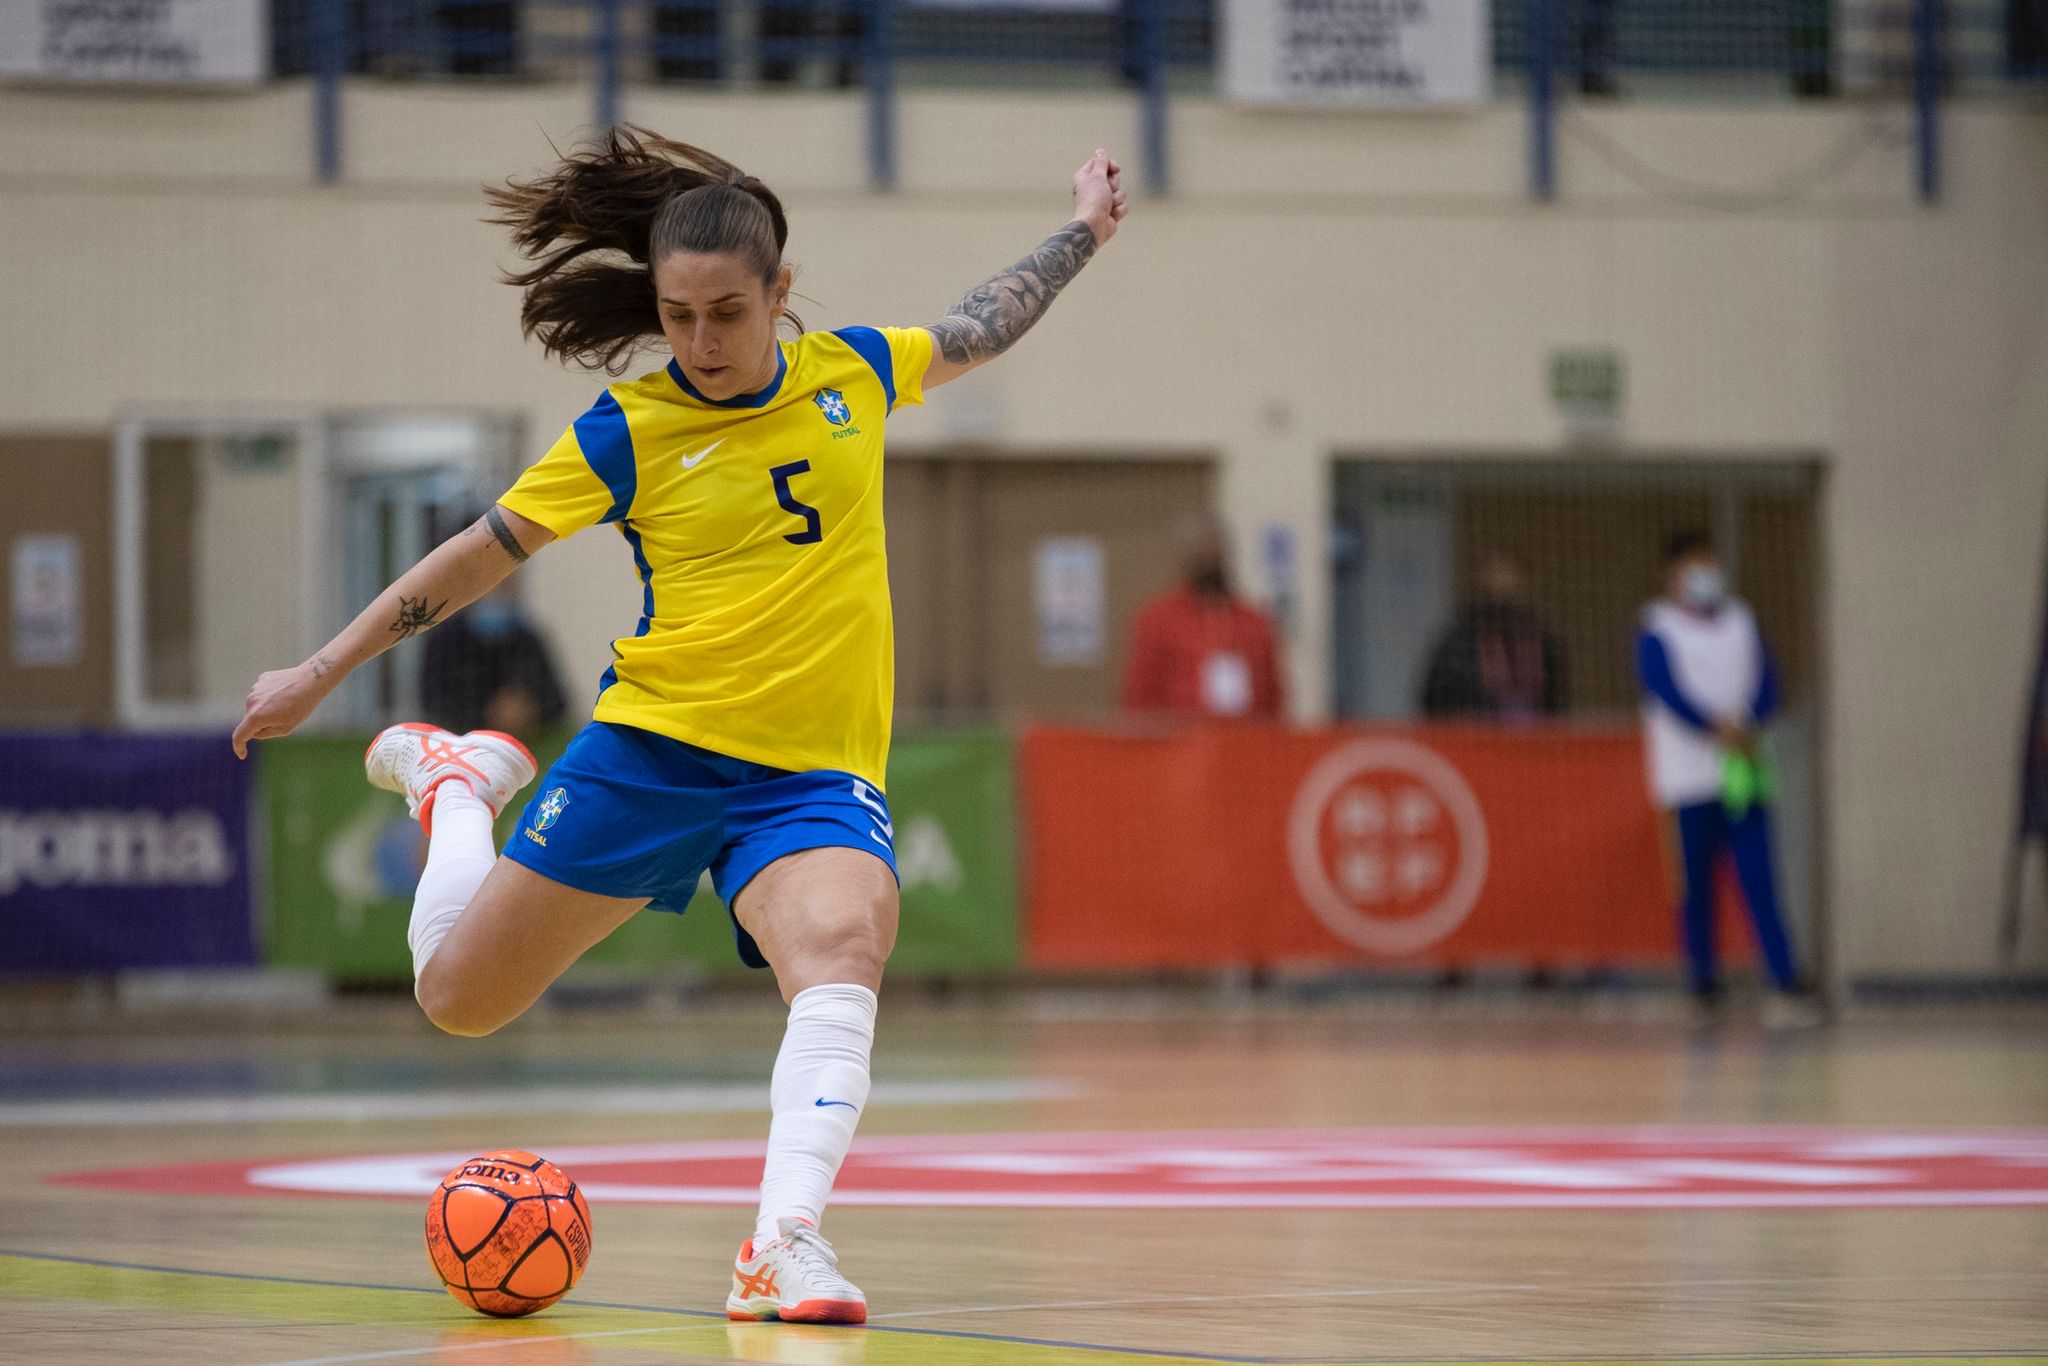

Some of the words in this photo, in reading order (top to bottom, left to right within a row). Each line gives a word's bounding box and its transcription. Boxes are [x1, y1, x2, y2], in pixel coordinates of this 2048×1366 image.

[832, 426, 861, 439] FUTSAL
[769, 458, 823, 545] 5
[524, 828, 547, 847] FUTSAL
